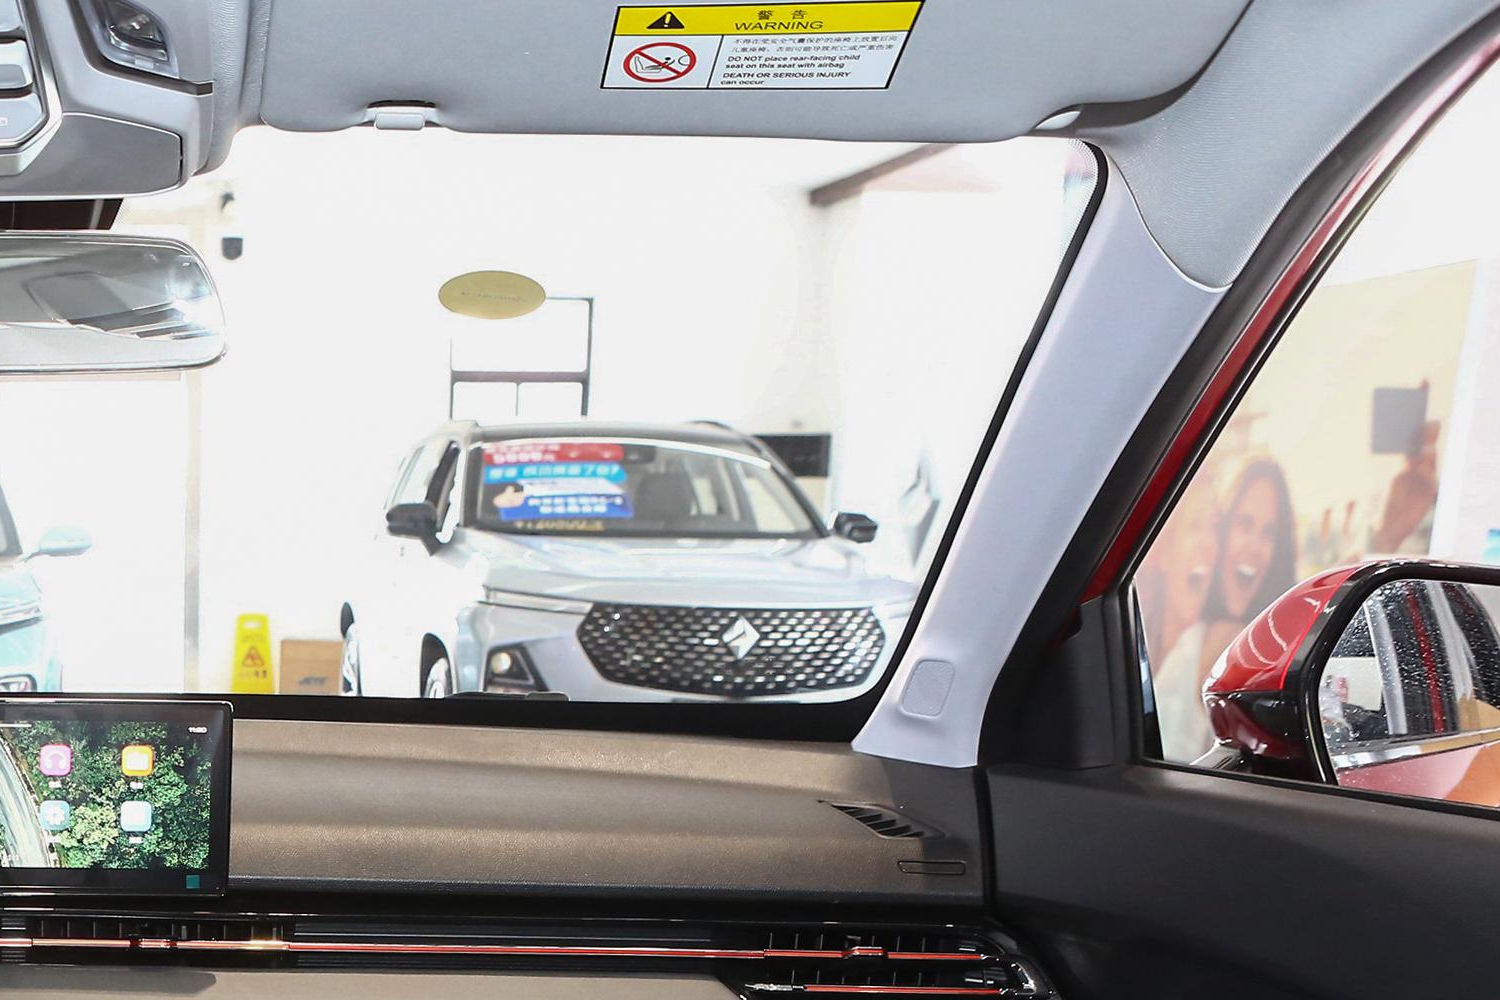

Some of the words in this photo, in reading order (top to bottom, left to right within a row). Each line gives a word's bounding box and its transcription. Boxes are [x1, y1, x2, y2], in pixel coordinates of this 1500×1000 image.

[757, 9, 807, 20] 警告
[734, 21, 824, 31] WARNING
[764, 55, 789, 63] place
[789, 54, 837, 63] rear-facing
[817, 62, 845, 70] airbag
